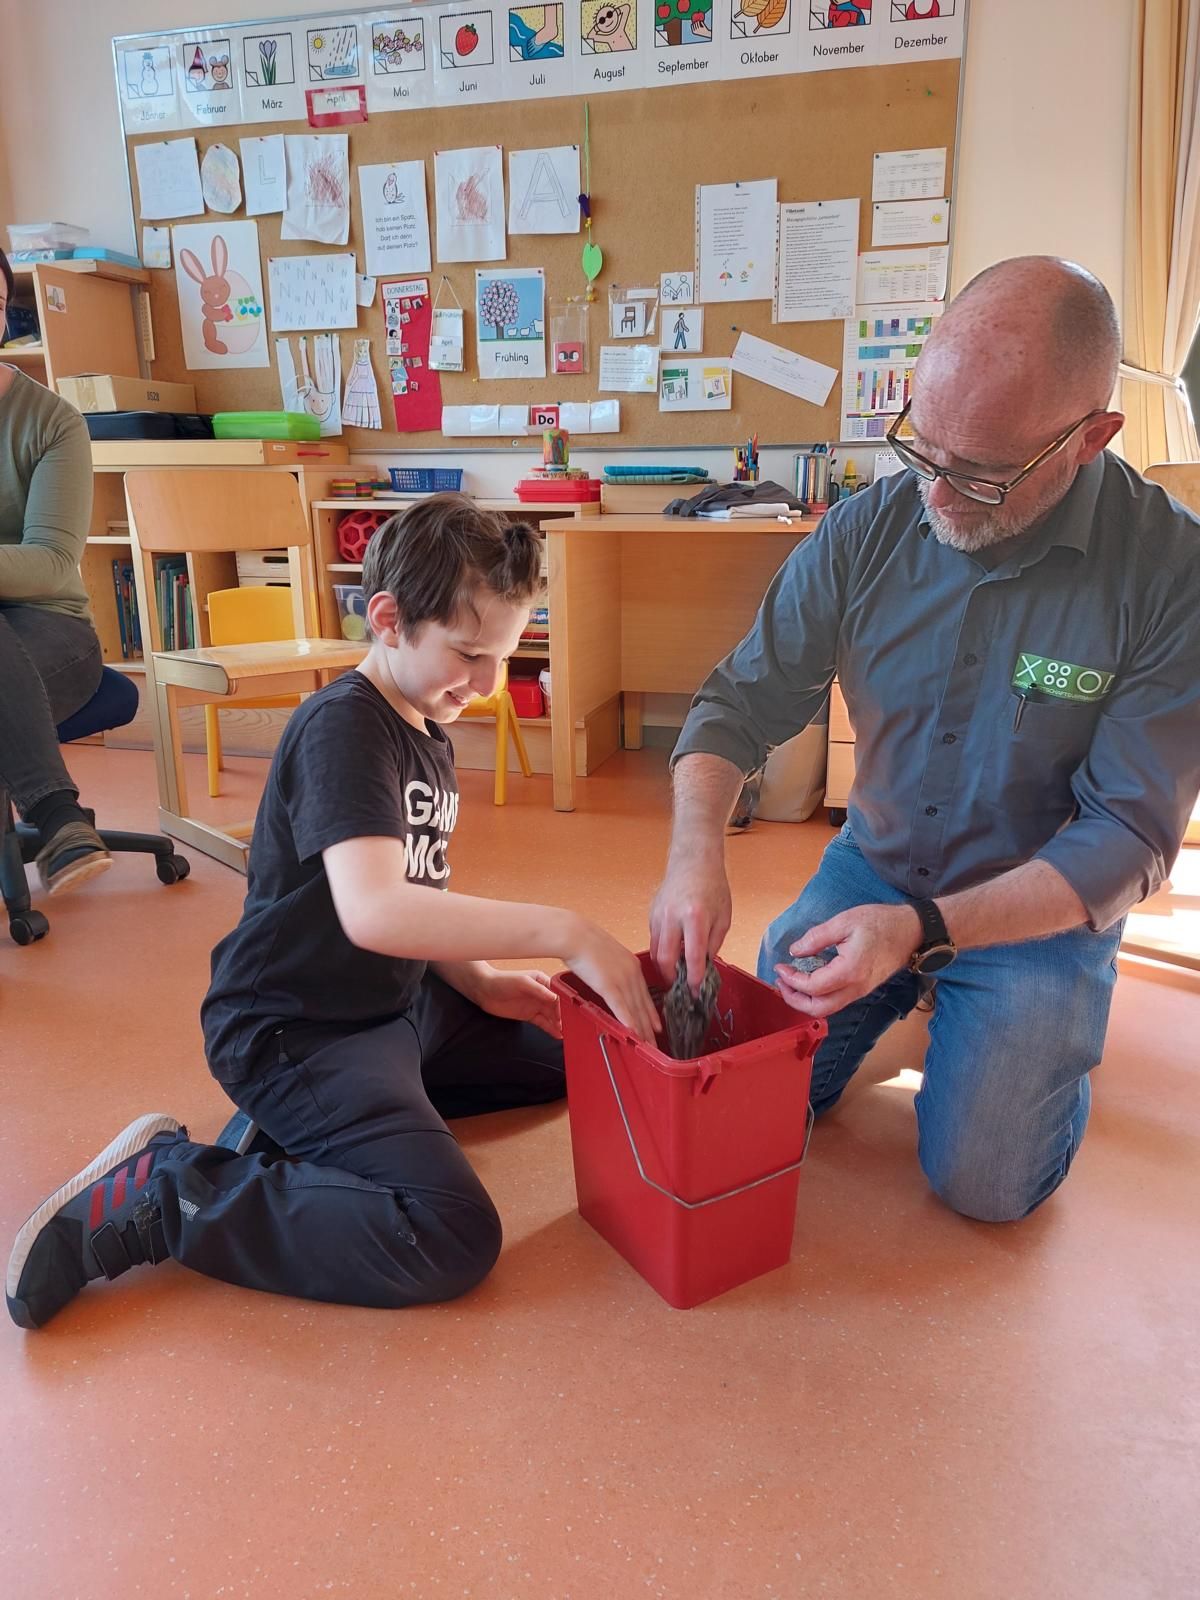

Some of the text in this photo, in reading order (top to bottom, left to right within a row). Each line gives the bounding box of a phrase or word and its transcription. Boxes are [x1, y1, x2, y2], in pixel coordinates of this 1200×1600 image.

[894, 35, 948, 50] Dezember
[813, 43, 865, 57] November
[740, 51, 779, 65] Oktober
[593, 66, 625, 82] August
[657, 59, 709, 75] September
[459, 81, 478, 92] Juni
[529, 74, 546, 86] Juli
[393, 86, 410, 98] Mai
[262, 98, 283, 110] März
[326, 91, 346, 108] April
[196, 103, 227, 116] Februar
[386, 284, 424, 295] DONNERSTAG
[494, 351, 529, 365] Frühling
[538, 414, 555, 425] Do
[404, 780, 460, 833] GAM
